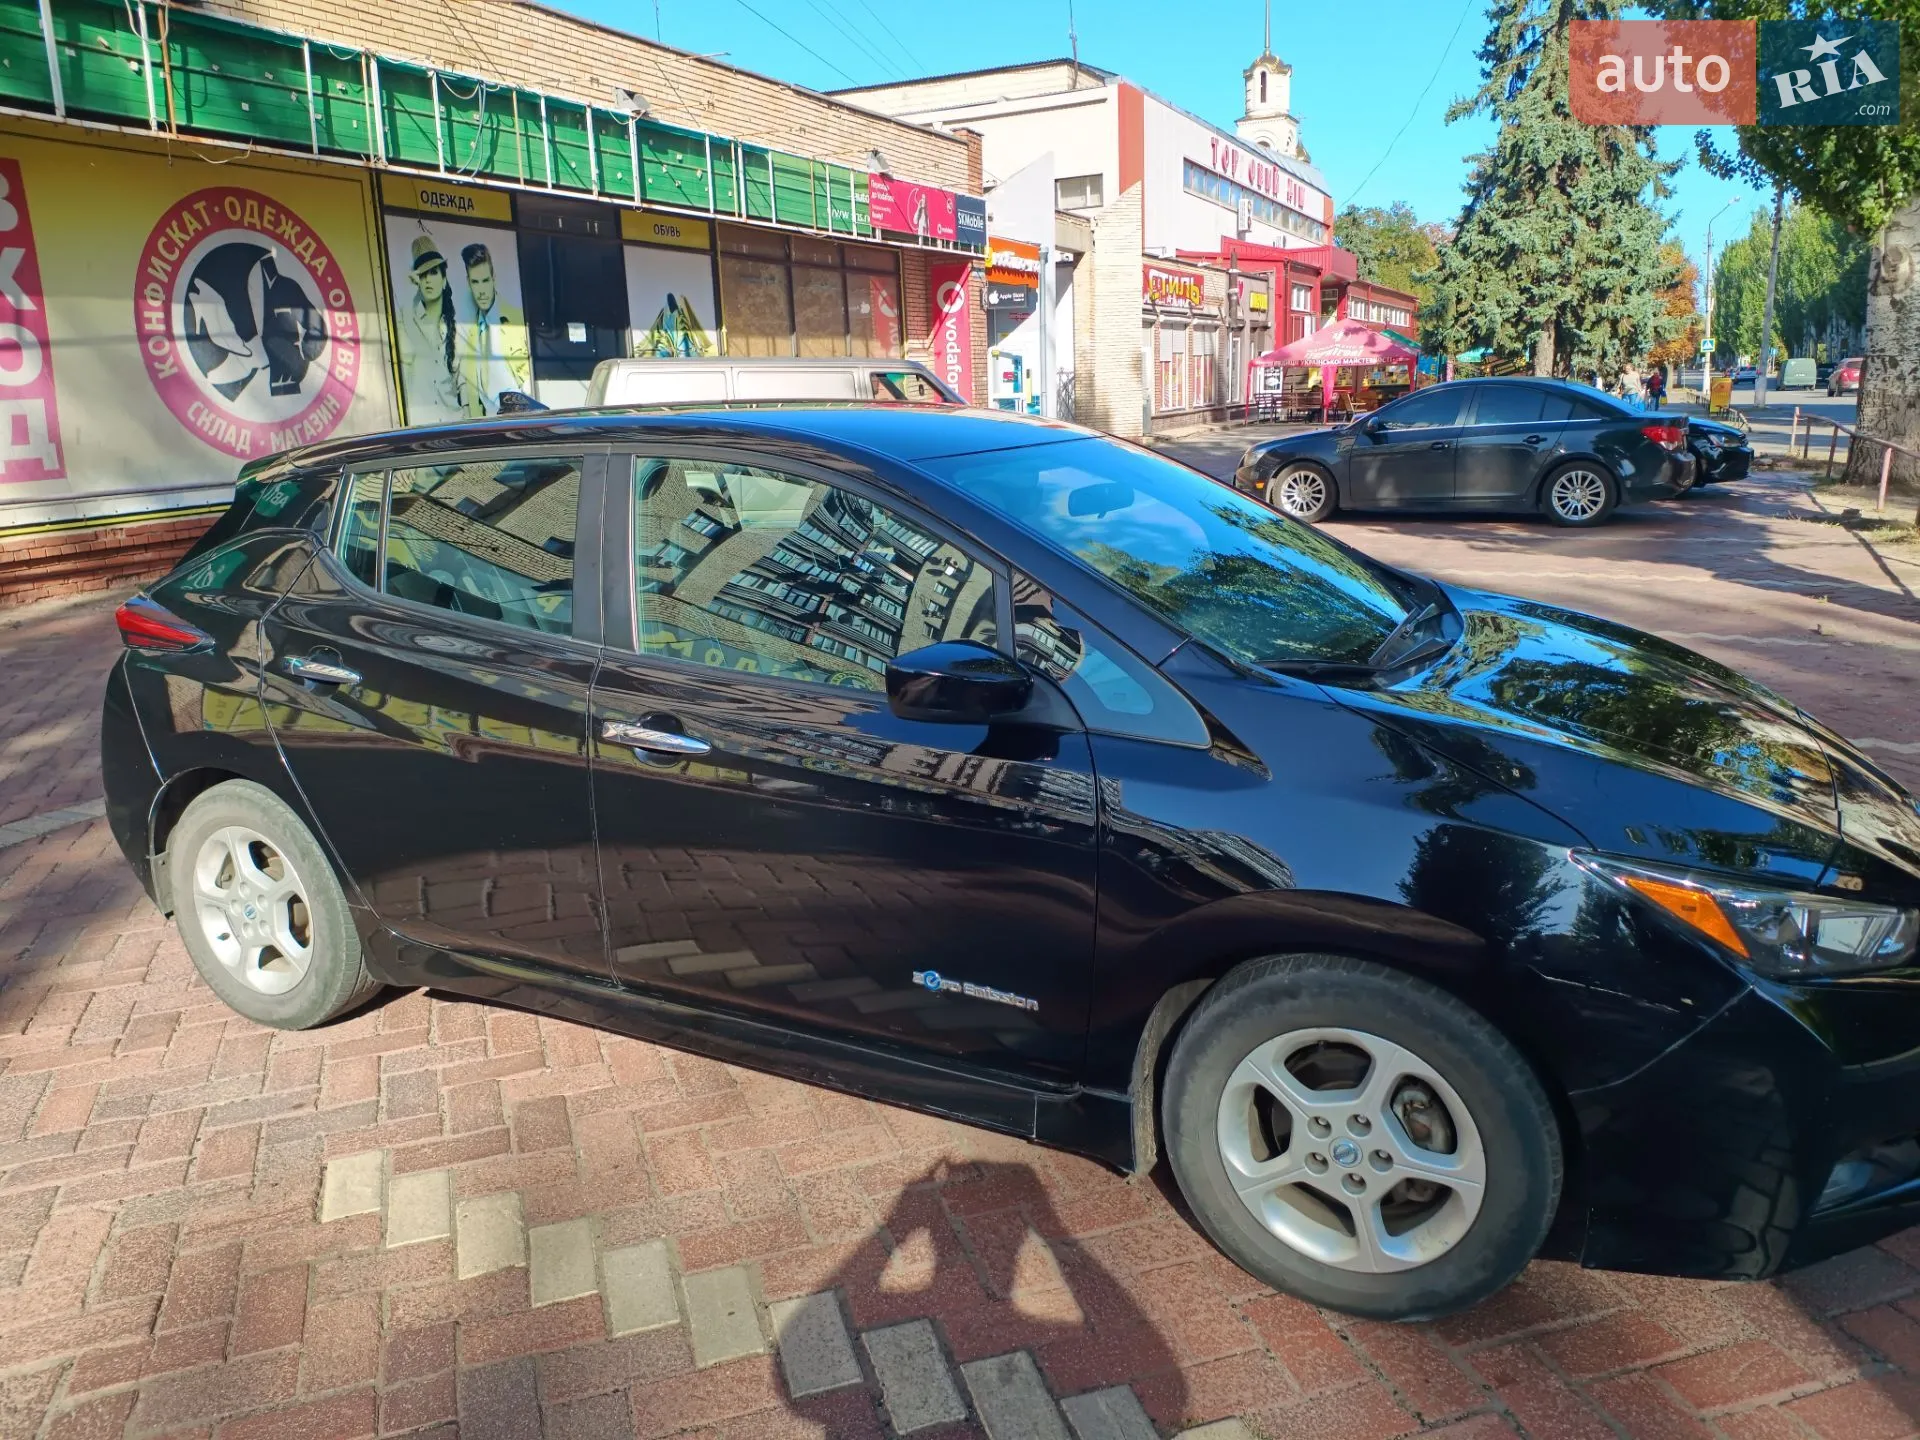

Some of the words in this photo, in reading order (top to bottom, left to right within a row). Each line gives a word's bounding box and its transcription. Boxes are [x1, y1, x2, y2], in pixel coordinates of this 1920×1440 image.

[420, 190, 475, 212] ОДЕЖДА
[653, 223, 682, 238] ОБУВЬ
[144, 200, 214, 380] КОНФИСКАТ
[224, 195, 331, 278] ОДЕЖДА
[328, 288, 356, 382] ОБУВЬ
[187, 401, 252, 454] СКЛАД
[271, 393, 342, 452] МАГАЗИН
